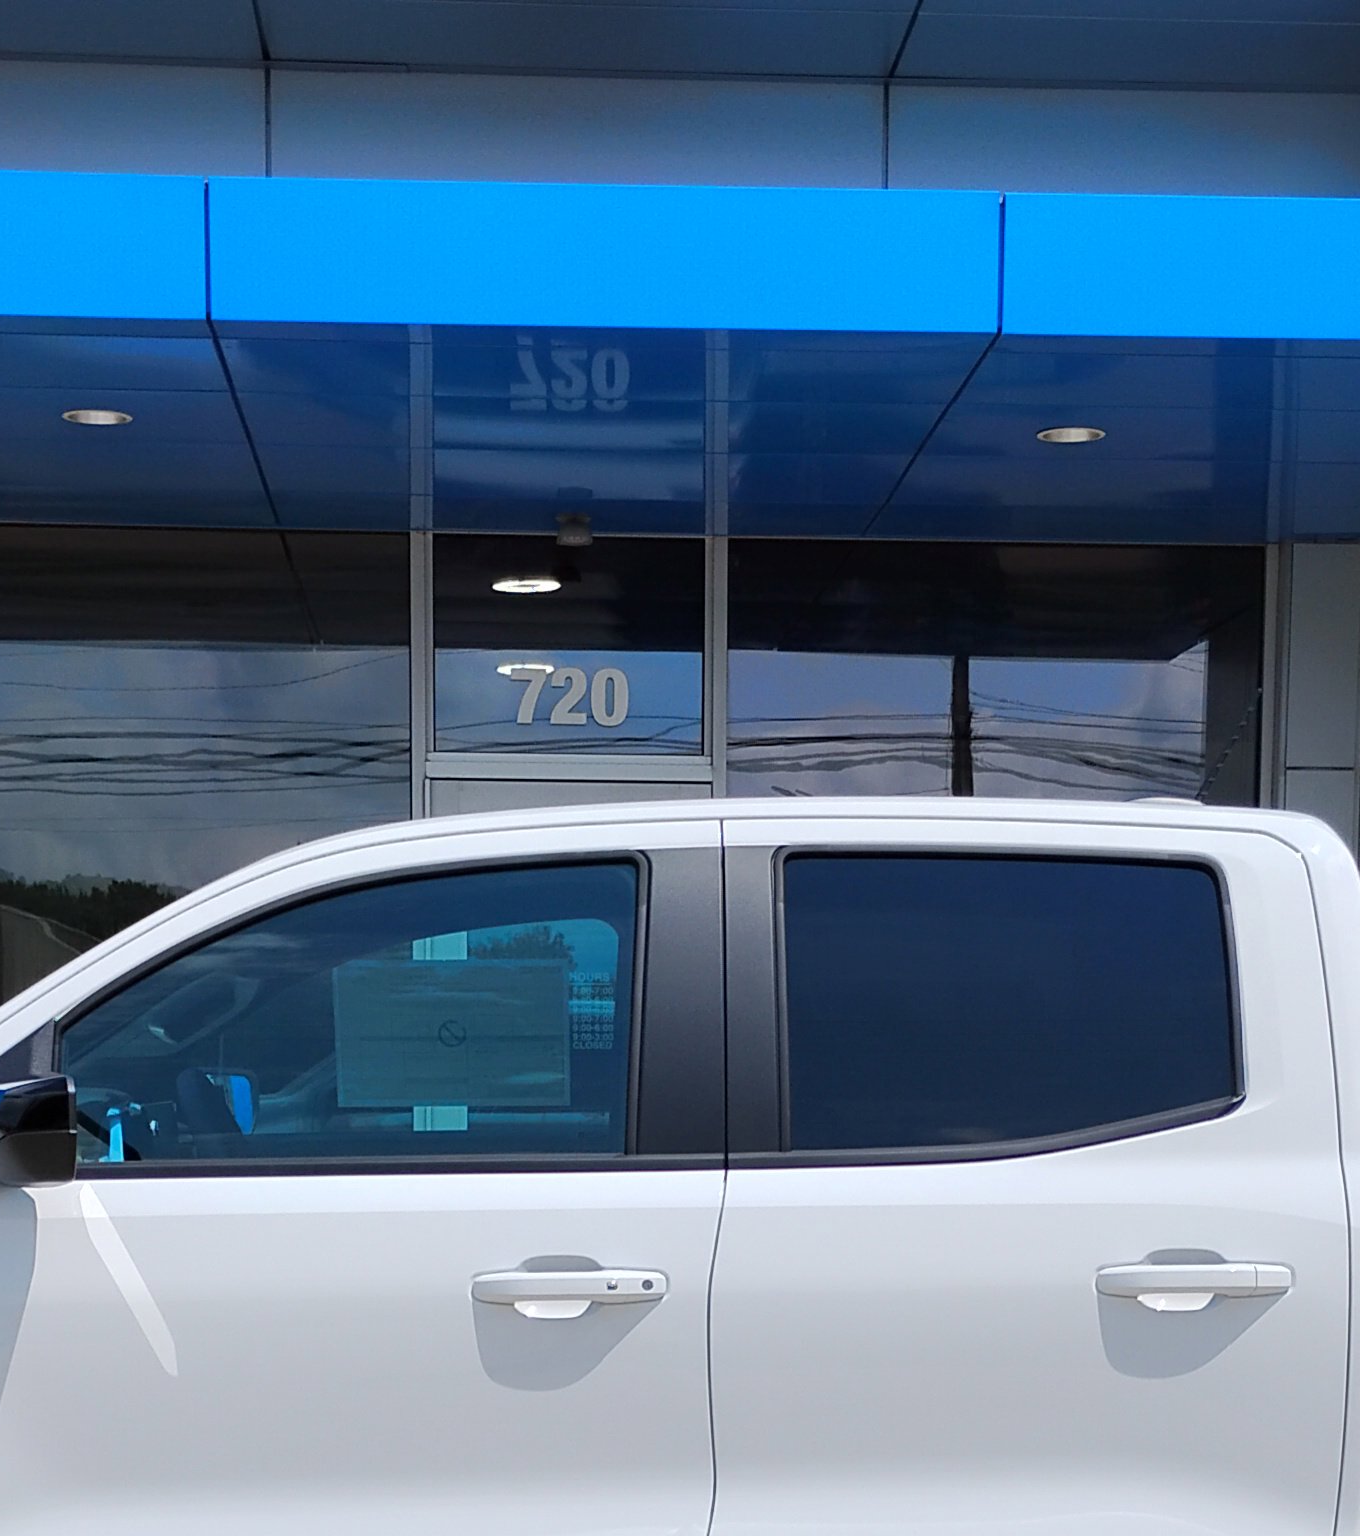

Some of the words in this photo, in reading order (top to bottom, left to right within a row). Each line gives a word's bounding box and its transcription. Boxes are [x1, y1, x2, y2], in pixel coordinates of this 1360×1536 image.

[510, 667, 630, 727] 720
[569, 972, 610, 982] HOURS
[572, 1040, 613, 1050] CLOSED
